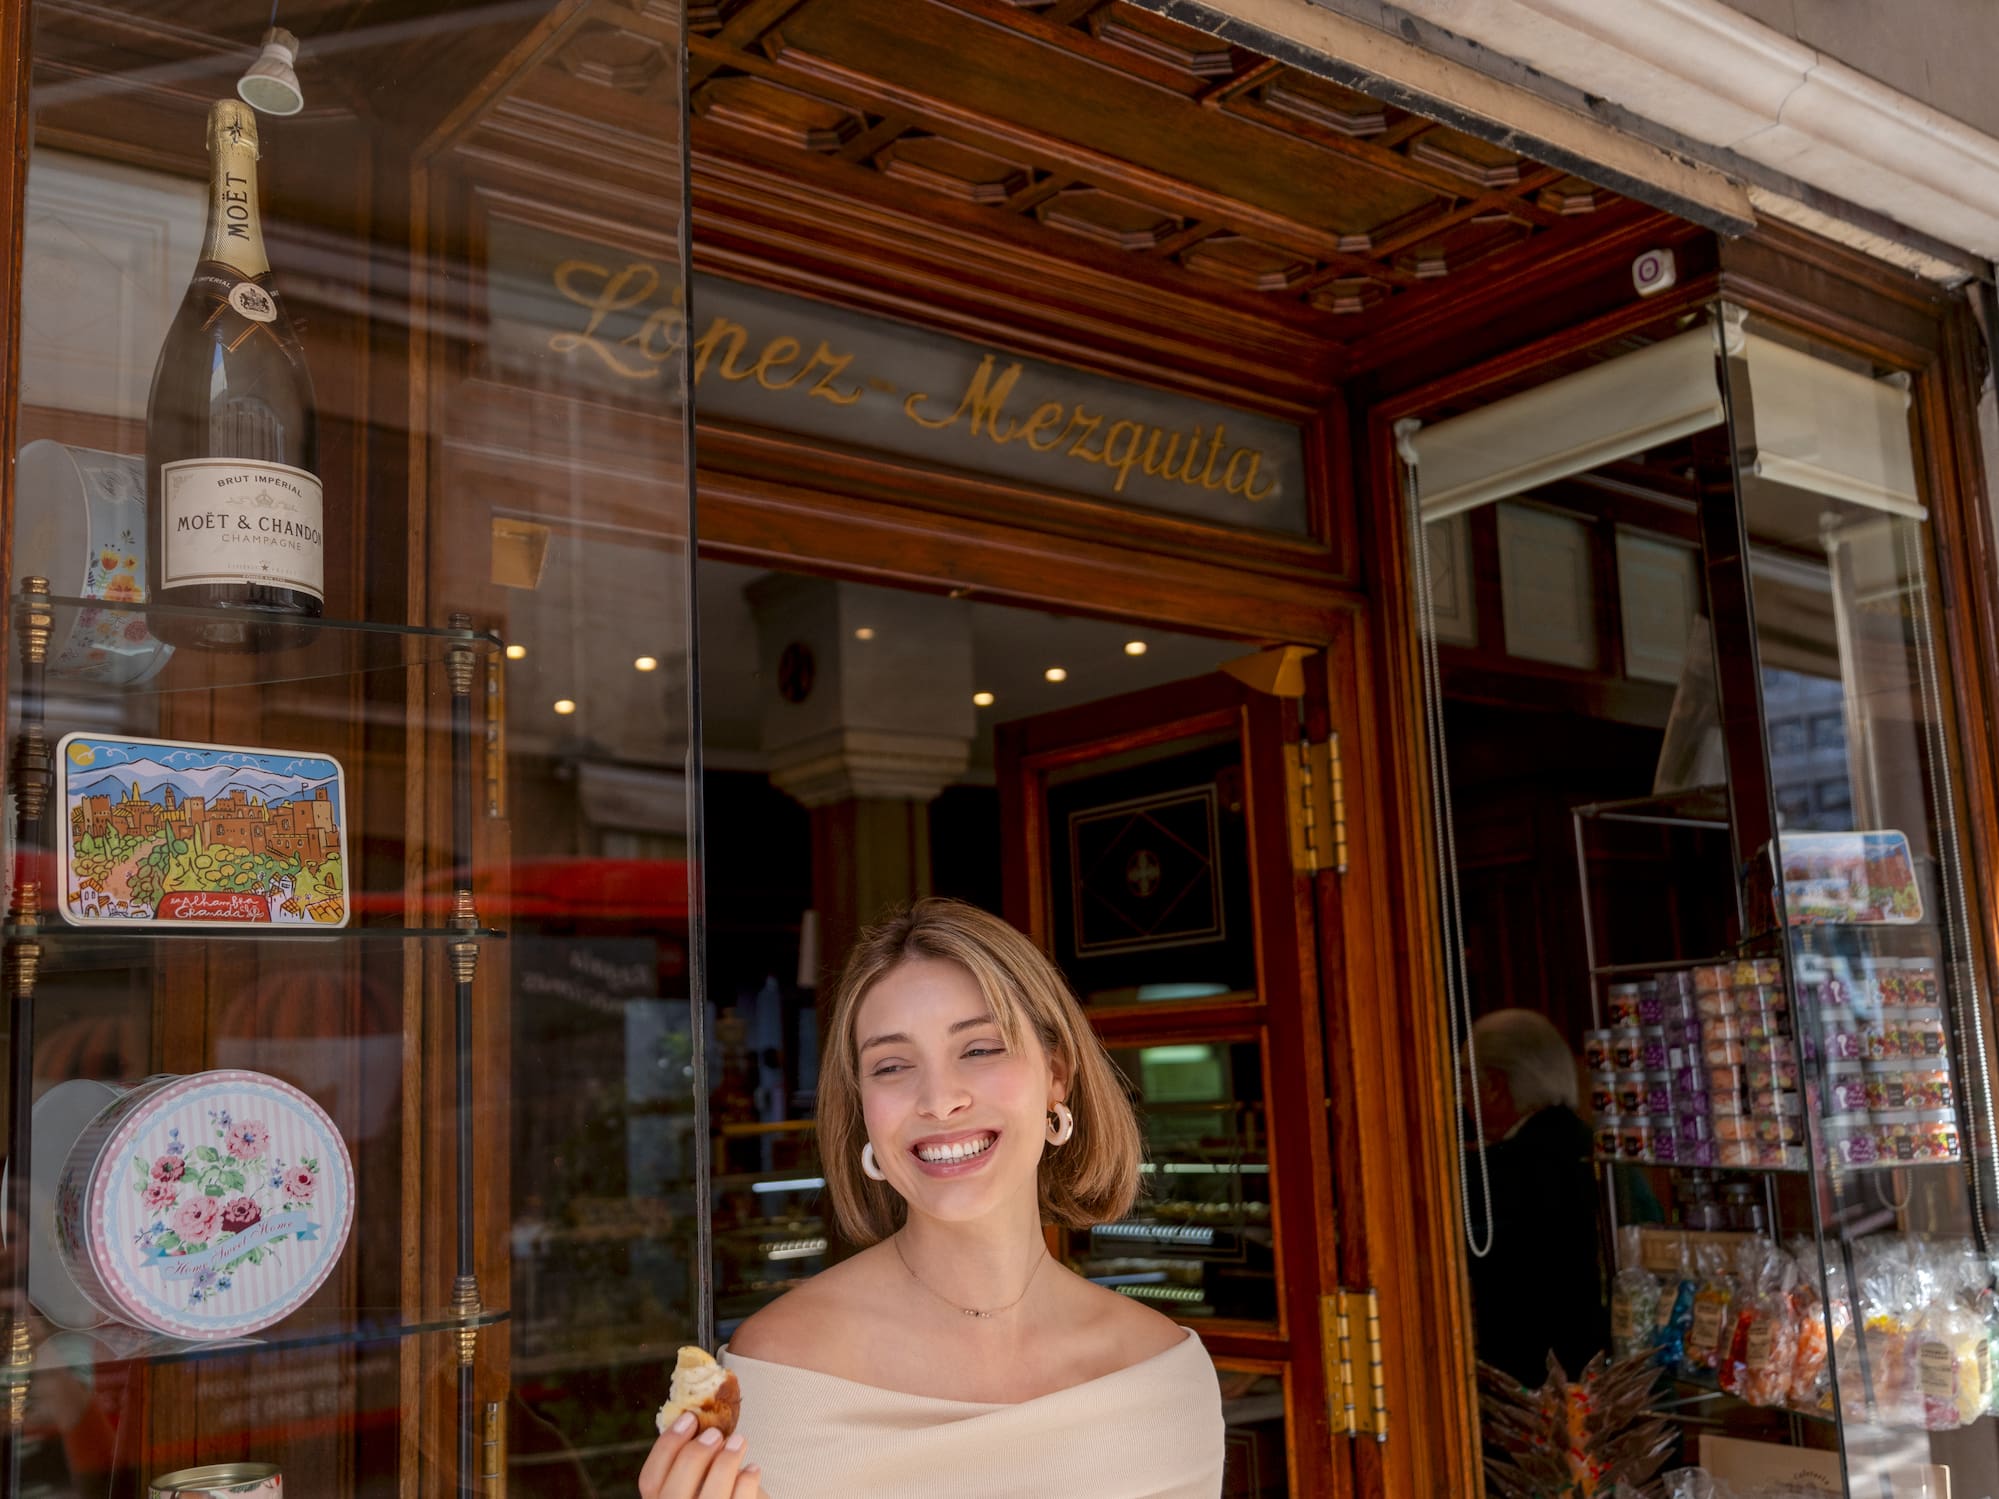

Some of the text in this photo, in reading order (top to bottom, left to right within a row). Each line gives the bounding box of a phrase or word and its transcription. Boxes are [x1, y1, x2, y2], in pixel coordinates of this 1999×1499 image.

[222, 171, 250, 241] MOËT
[217, 475, 250, 488] BRUT
[177, 512, 230, 532] MOËT
[237, 514, 253, 530] &
[221, 533, 303, 551] CHAMPAGNE
[175, 903, 244, 919] Granada
[166, 1221, 294, 1274] Home Sweet Home
